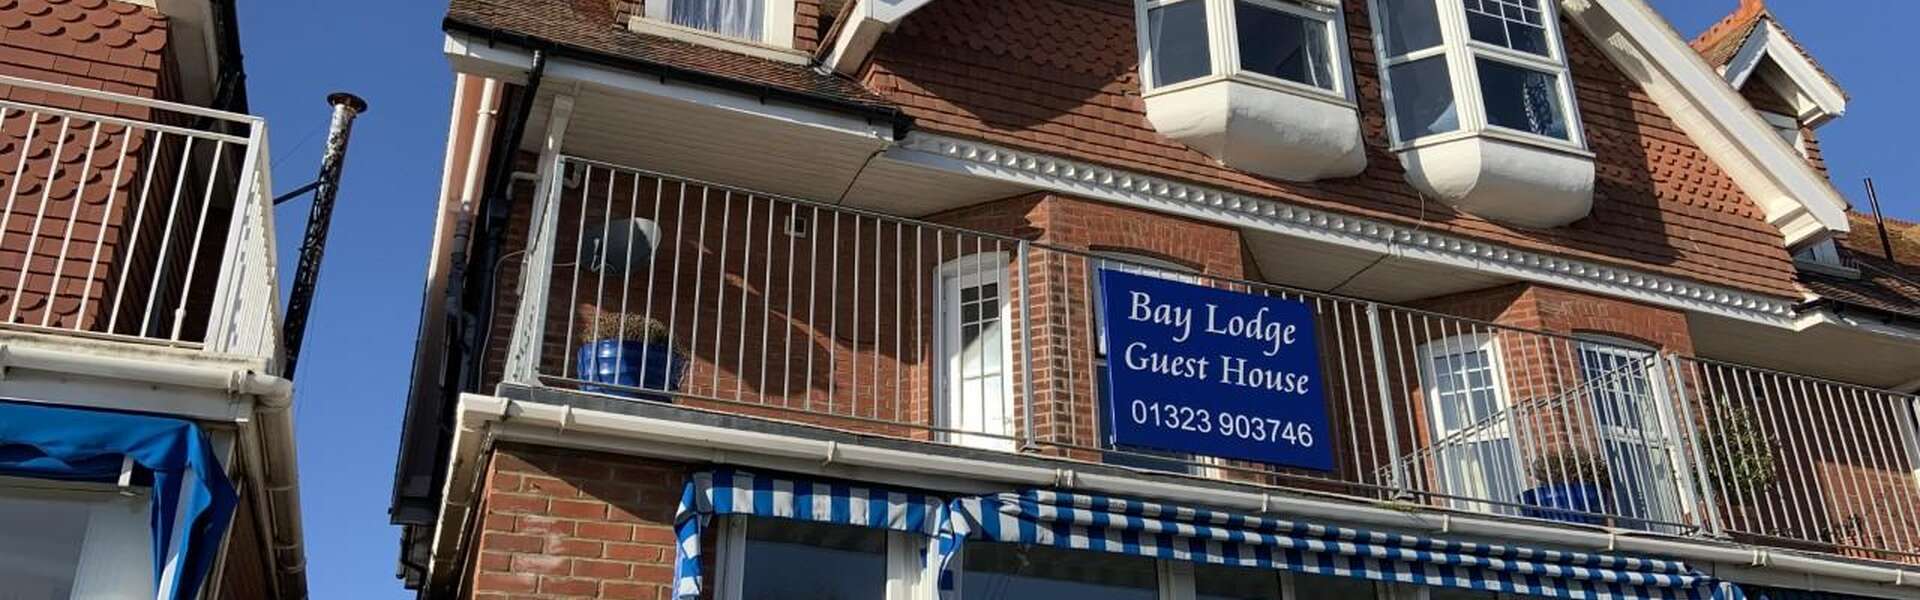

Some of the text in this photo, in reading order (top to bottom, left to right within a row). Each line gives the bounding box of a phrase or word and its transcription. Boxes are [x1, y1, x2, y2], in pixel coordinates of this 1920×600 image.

[1128, 290, 1296, 356] Bay Lodge
[1125, 342, 1309, 395] Guest House
[1132, 399, 1313, 447] 01323 903746
